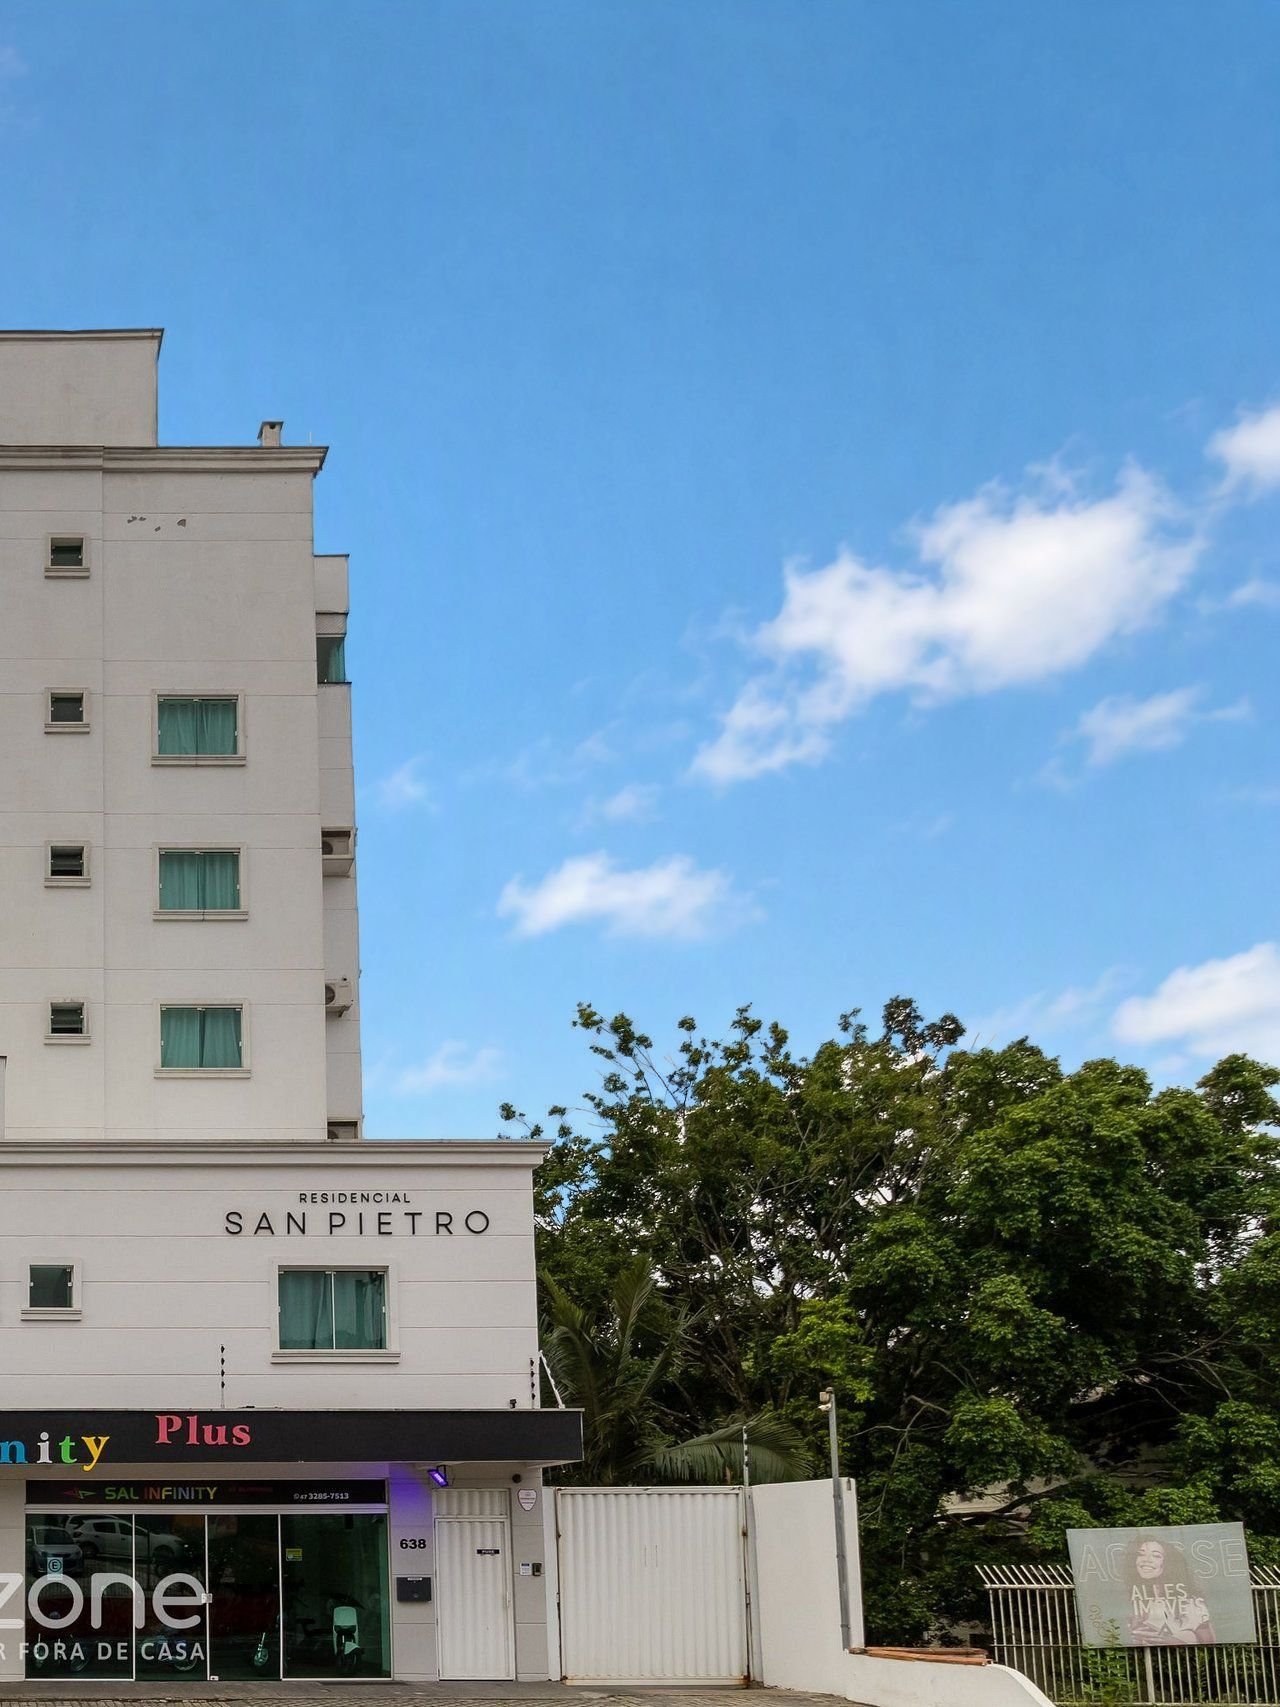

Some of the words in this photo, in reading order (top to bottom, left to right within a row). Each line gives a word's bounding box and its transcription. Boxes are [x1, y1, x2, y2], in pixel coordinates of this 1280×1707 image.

[299, 1193, 411, 1203] RESIDENCIAL
[225, 1211, 306, 1235] SAN
[329, 1210, 490, 1235] PIETRO
[155, 1414, 252, 1447] Plus
[105, 1487, 139, 1499] SAL
[144, 1487, 218, 1499] INFINITY
[400, 1538, 427, 1550] 638
[1079, 1538, 1249, 1583] ACSE
[1131, 1583, 1188, 1601] ALLES
